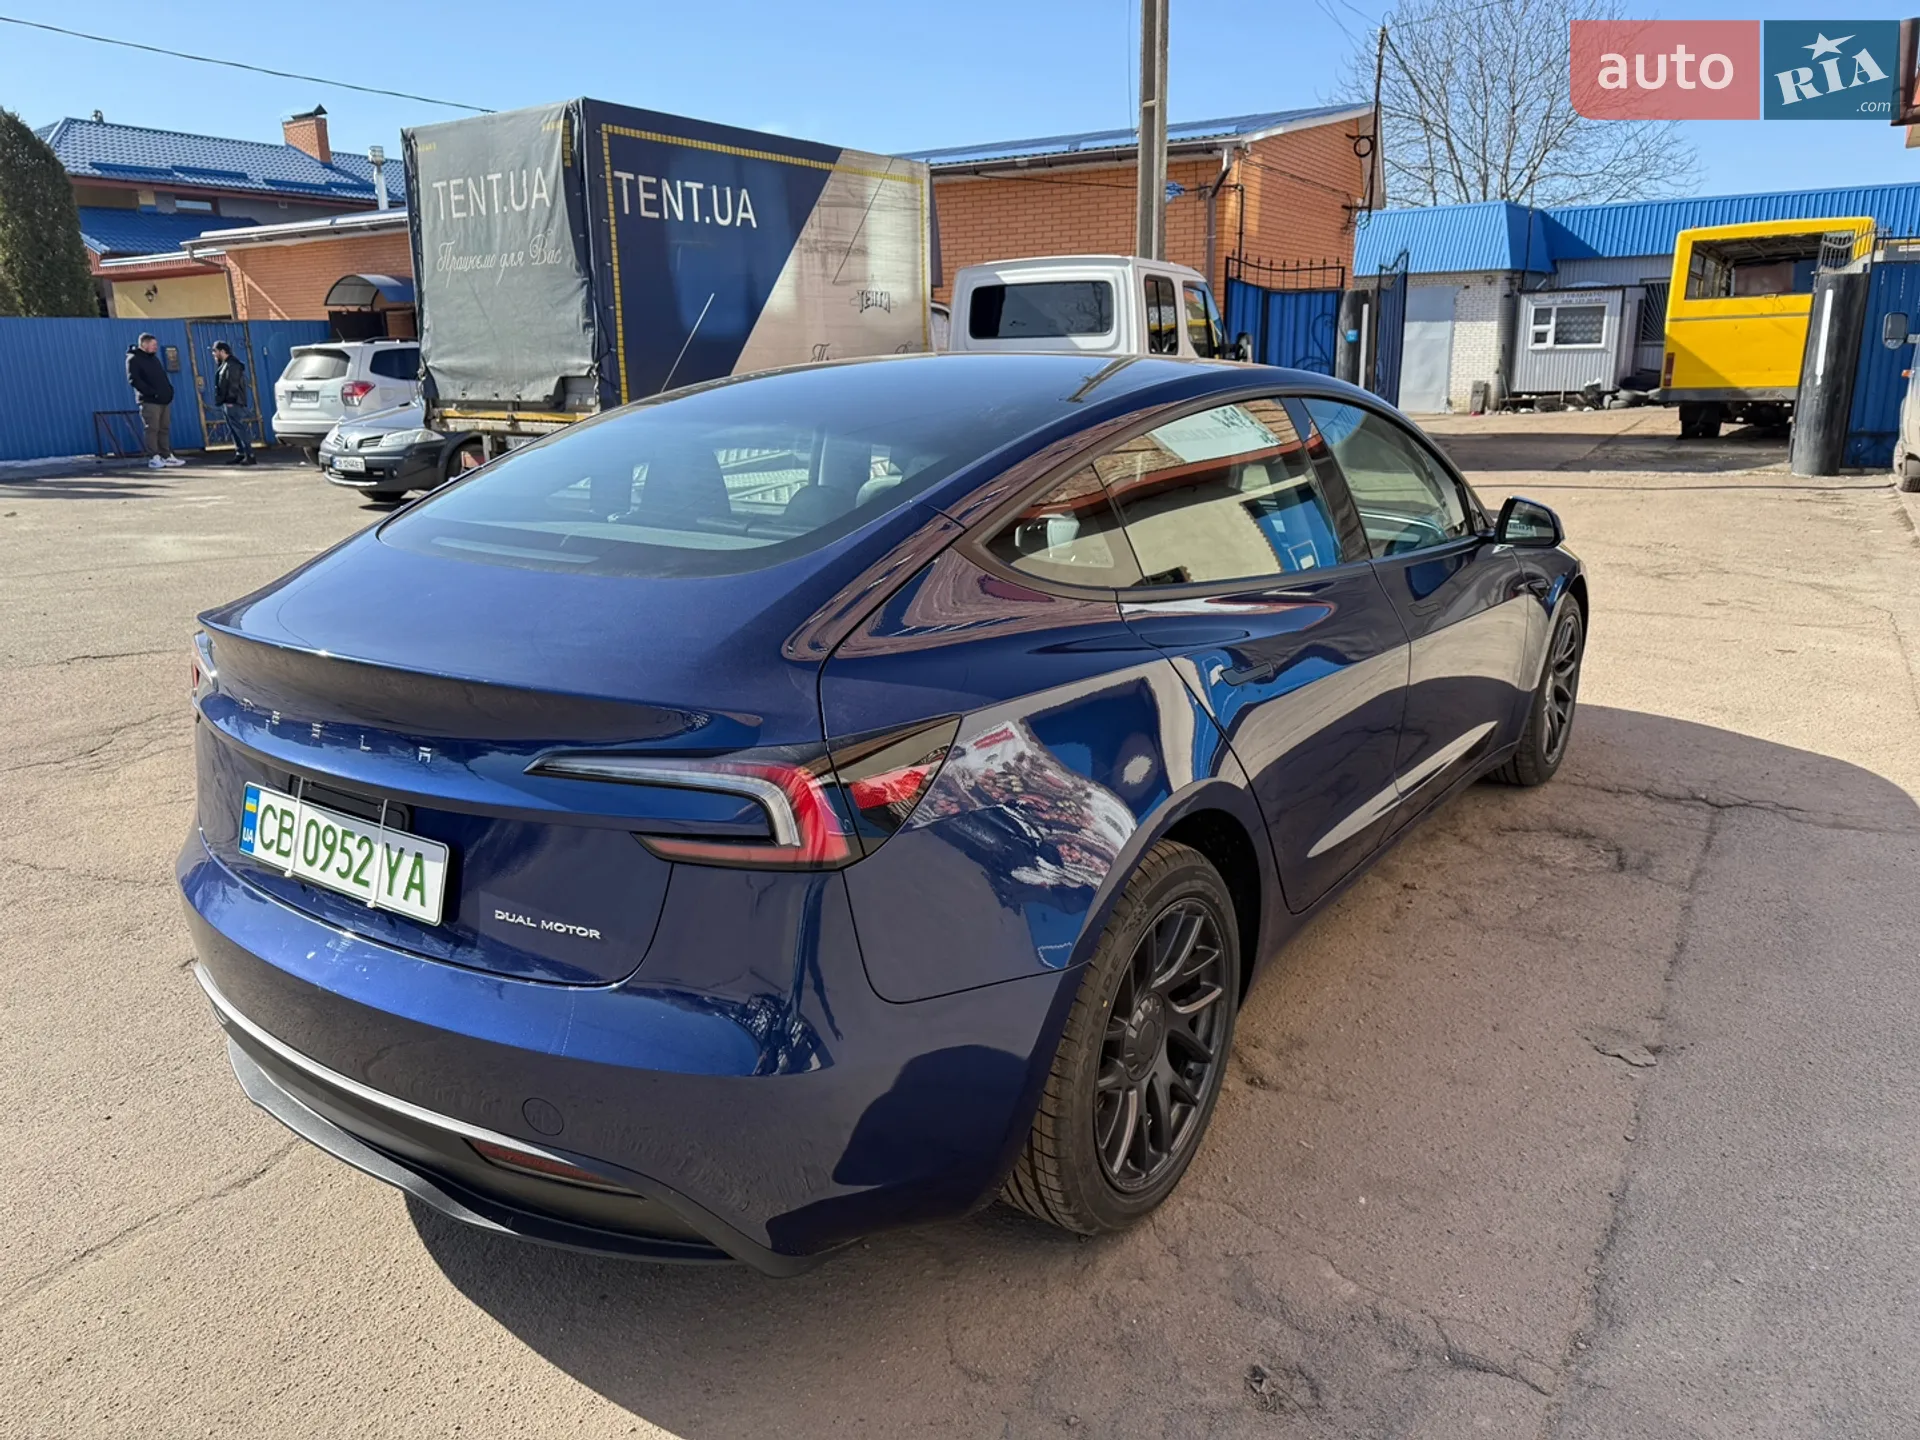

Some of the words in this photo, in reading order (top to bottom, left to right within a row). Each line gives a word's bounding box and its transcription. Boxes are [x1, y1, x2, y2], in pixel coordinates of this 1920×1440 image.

[432, 166, 551, 221] TENT.UA
[613, 170, 758, 228] TENT.UA
[242, 827, 254, 842] UA
[259, 804, 296, 857] CB
[303, 818, 374, 888] 0952
[385, 842, 426, 908] YA
[494, 909, 537, 928] DUAL
[541, 920, 601, 939] MOTOR
